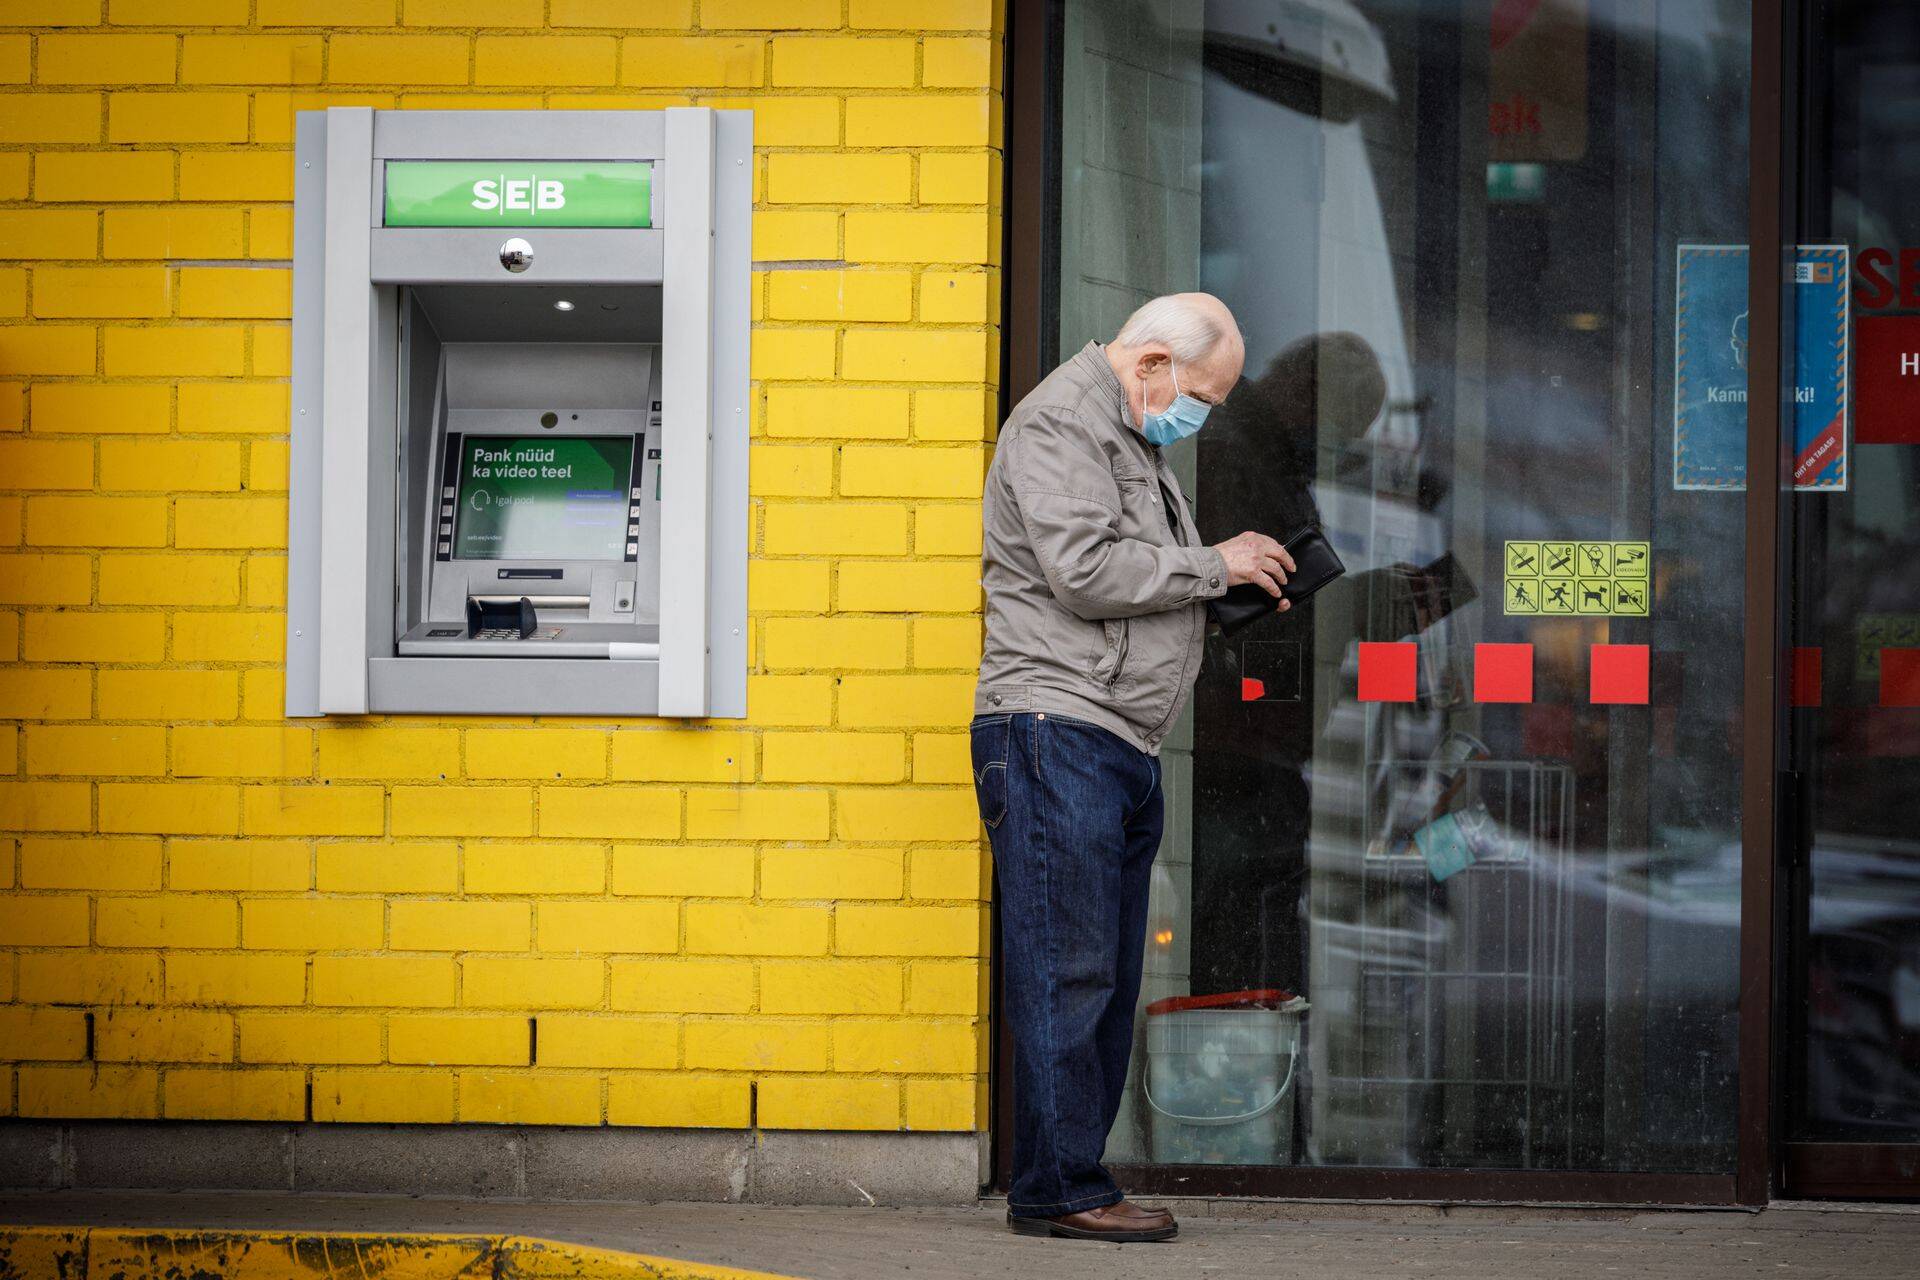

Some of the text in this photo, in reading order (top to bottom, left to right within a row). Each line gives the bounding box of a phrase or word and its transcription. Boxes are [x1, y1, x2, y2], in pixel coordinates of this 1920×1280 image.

[472, 174, 566, 216] SEB
[1708, 386, 1815, 403] Kann ki!
[474, 448, 555, 462] Pank nüüd
[472, 465, 572, 478] ka video teel
[1794, 464, 1806, 479] OHT
[1805, 456, 1816, 467] ON
